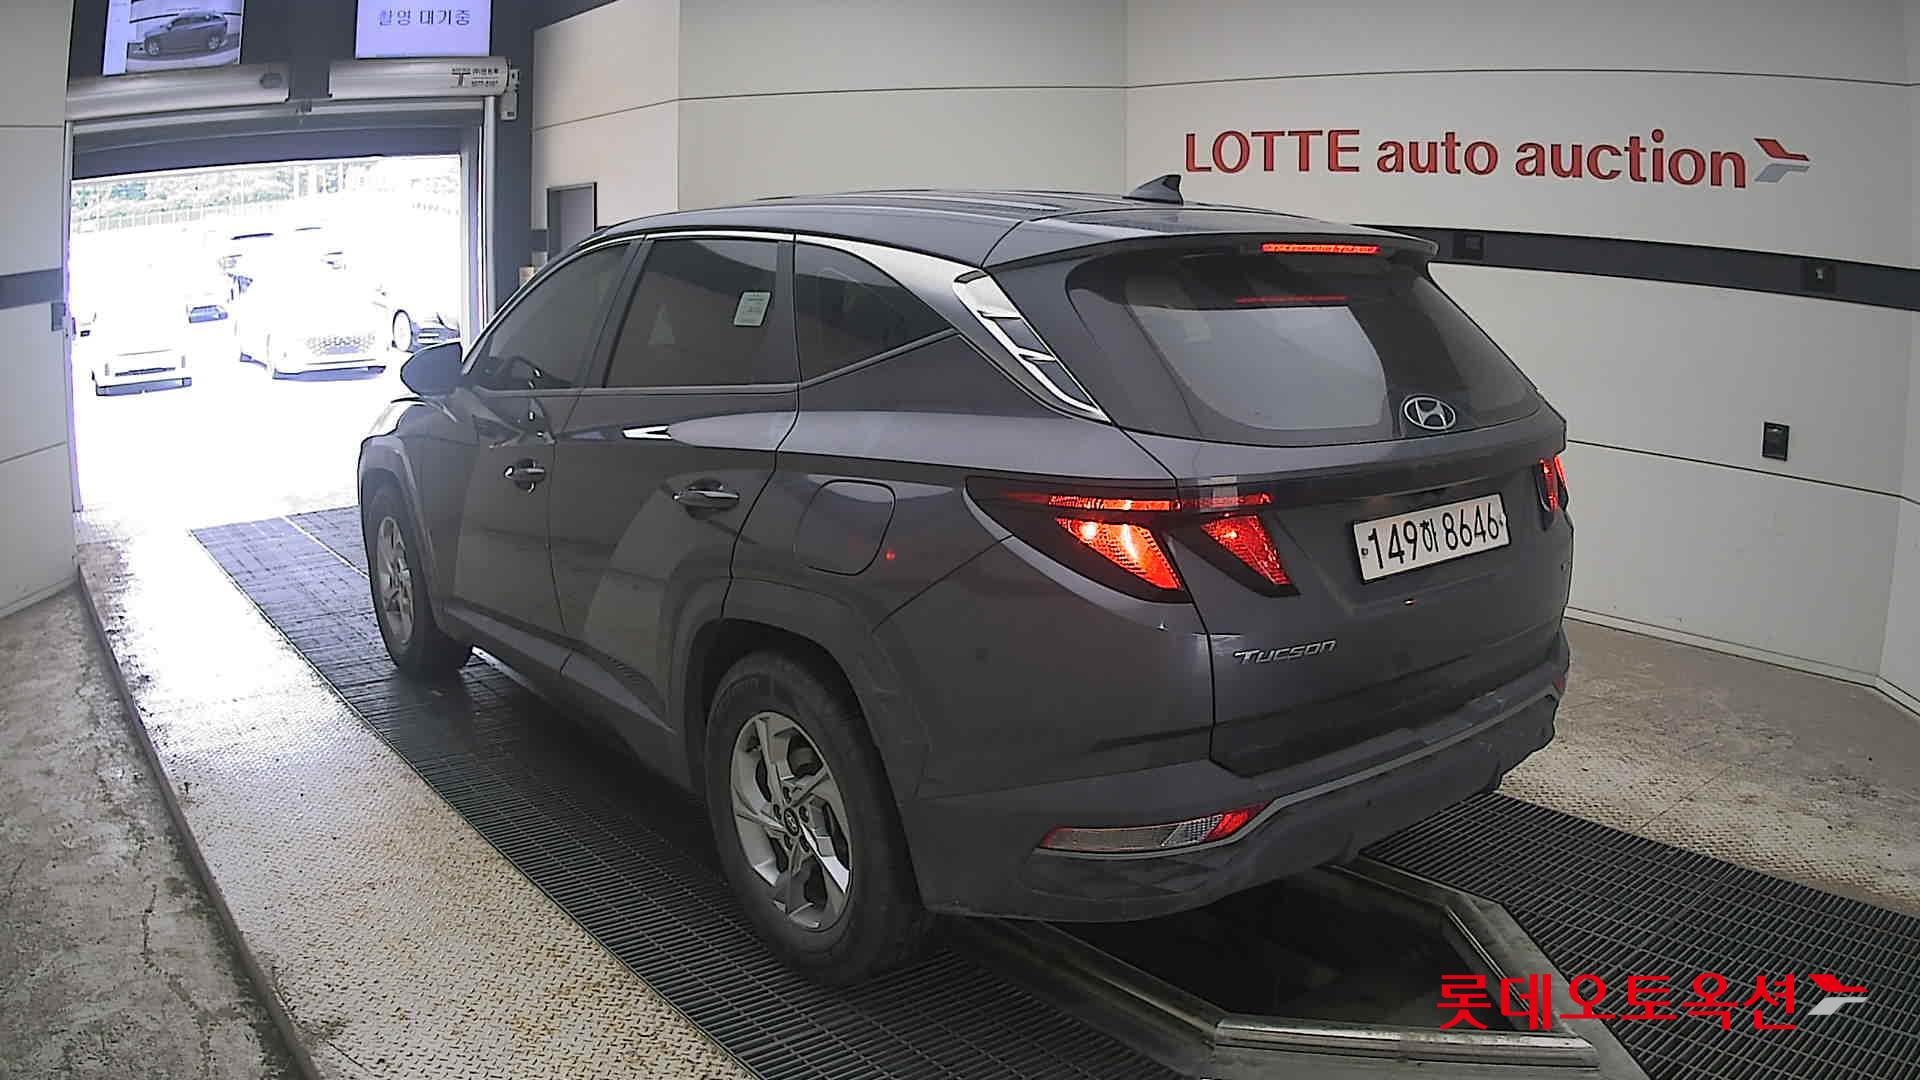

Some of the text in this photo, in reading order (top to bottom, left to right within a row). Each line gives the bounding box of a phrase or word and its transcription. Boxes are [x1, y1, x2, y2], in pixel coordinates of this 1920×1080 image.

[420, 9, 471, 26] 대기중
[1185, 129, 1746, 188] LOTTE auto auction
[1368, 503, 1499, 569] 149하 8646
